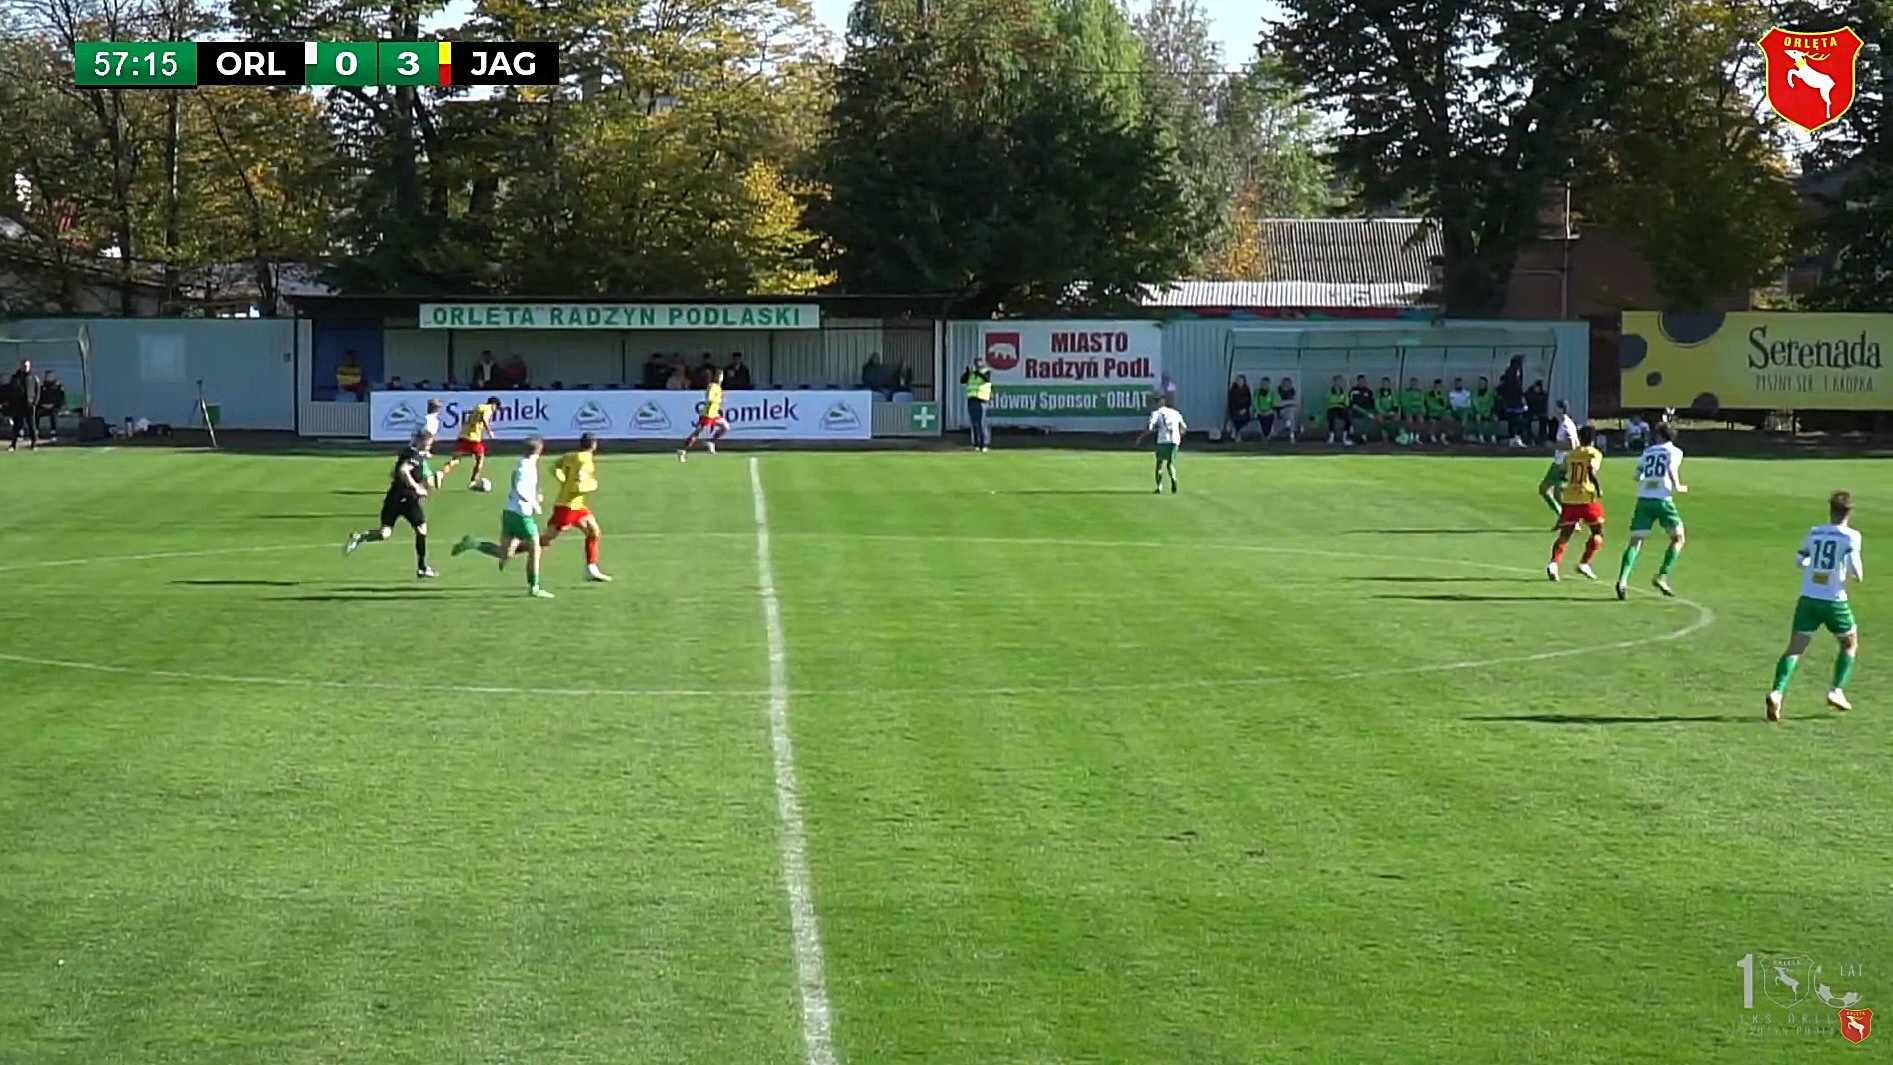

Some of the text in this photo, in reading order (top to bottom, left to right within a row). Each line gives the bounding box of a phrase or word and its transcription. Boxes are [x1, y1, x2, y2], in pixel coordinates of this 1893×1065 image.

[668, 307, 801, 326] PODLASKI
[1051, 332, 1128, 353] MIASTO
[1748, 324, 1883, 369] Serenada
[1025, 356, 1155, 381] Radzyń Podl.
[1039, 391, 1098, 411] Sponsor
[1570, 461, 1585, 485] 10
[1644, 454, 1667, 478] 26
[1813, 539, 1837, 570] 19
